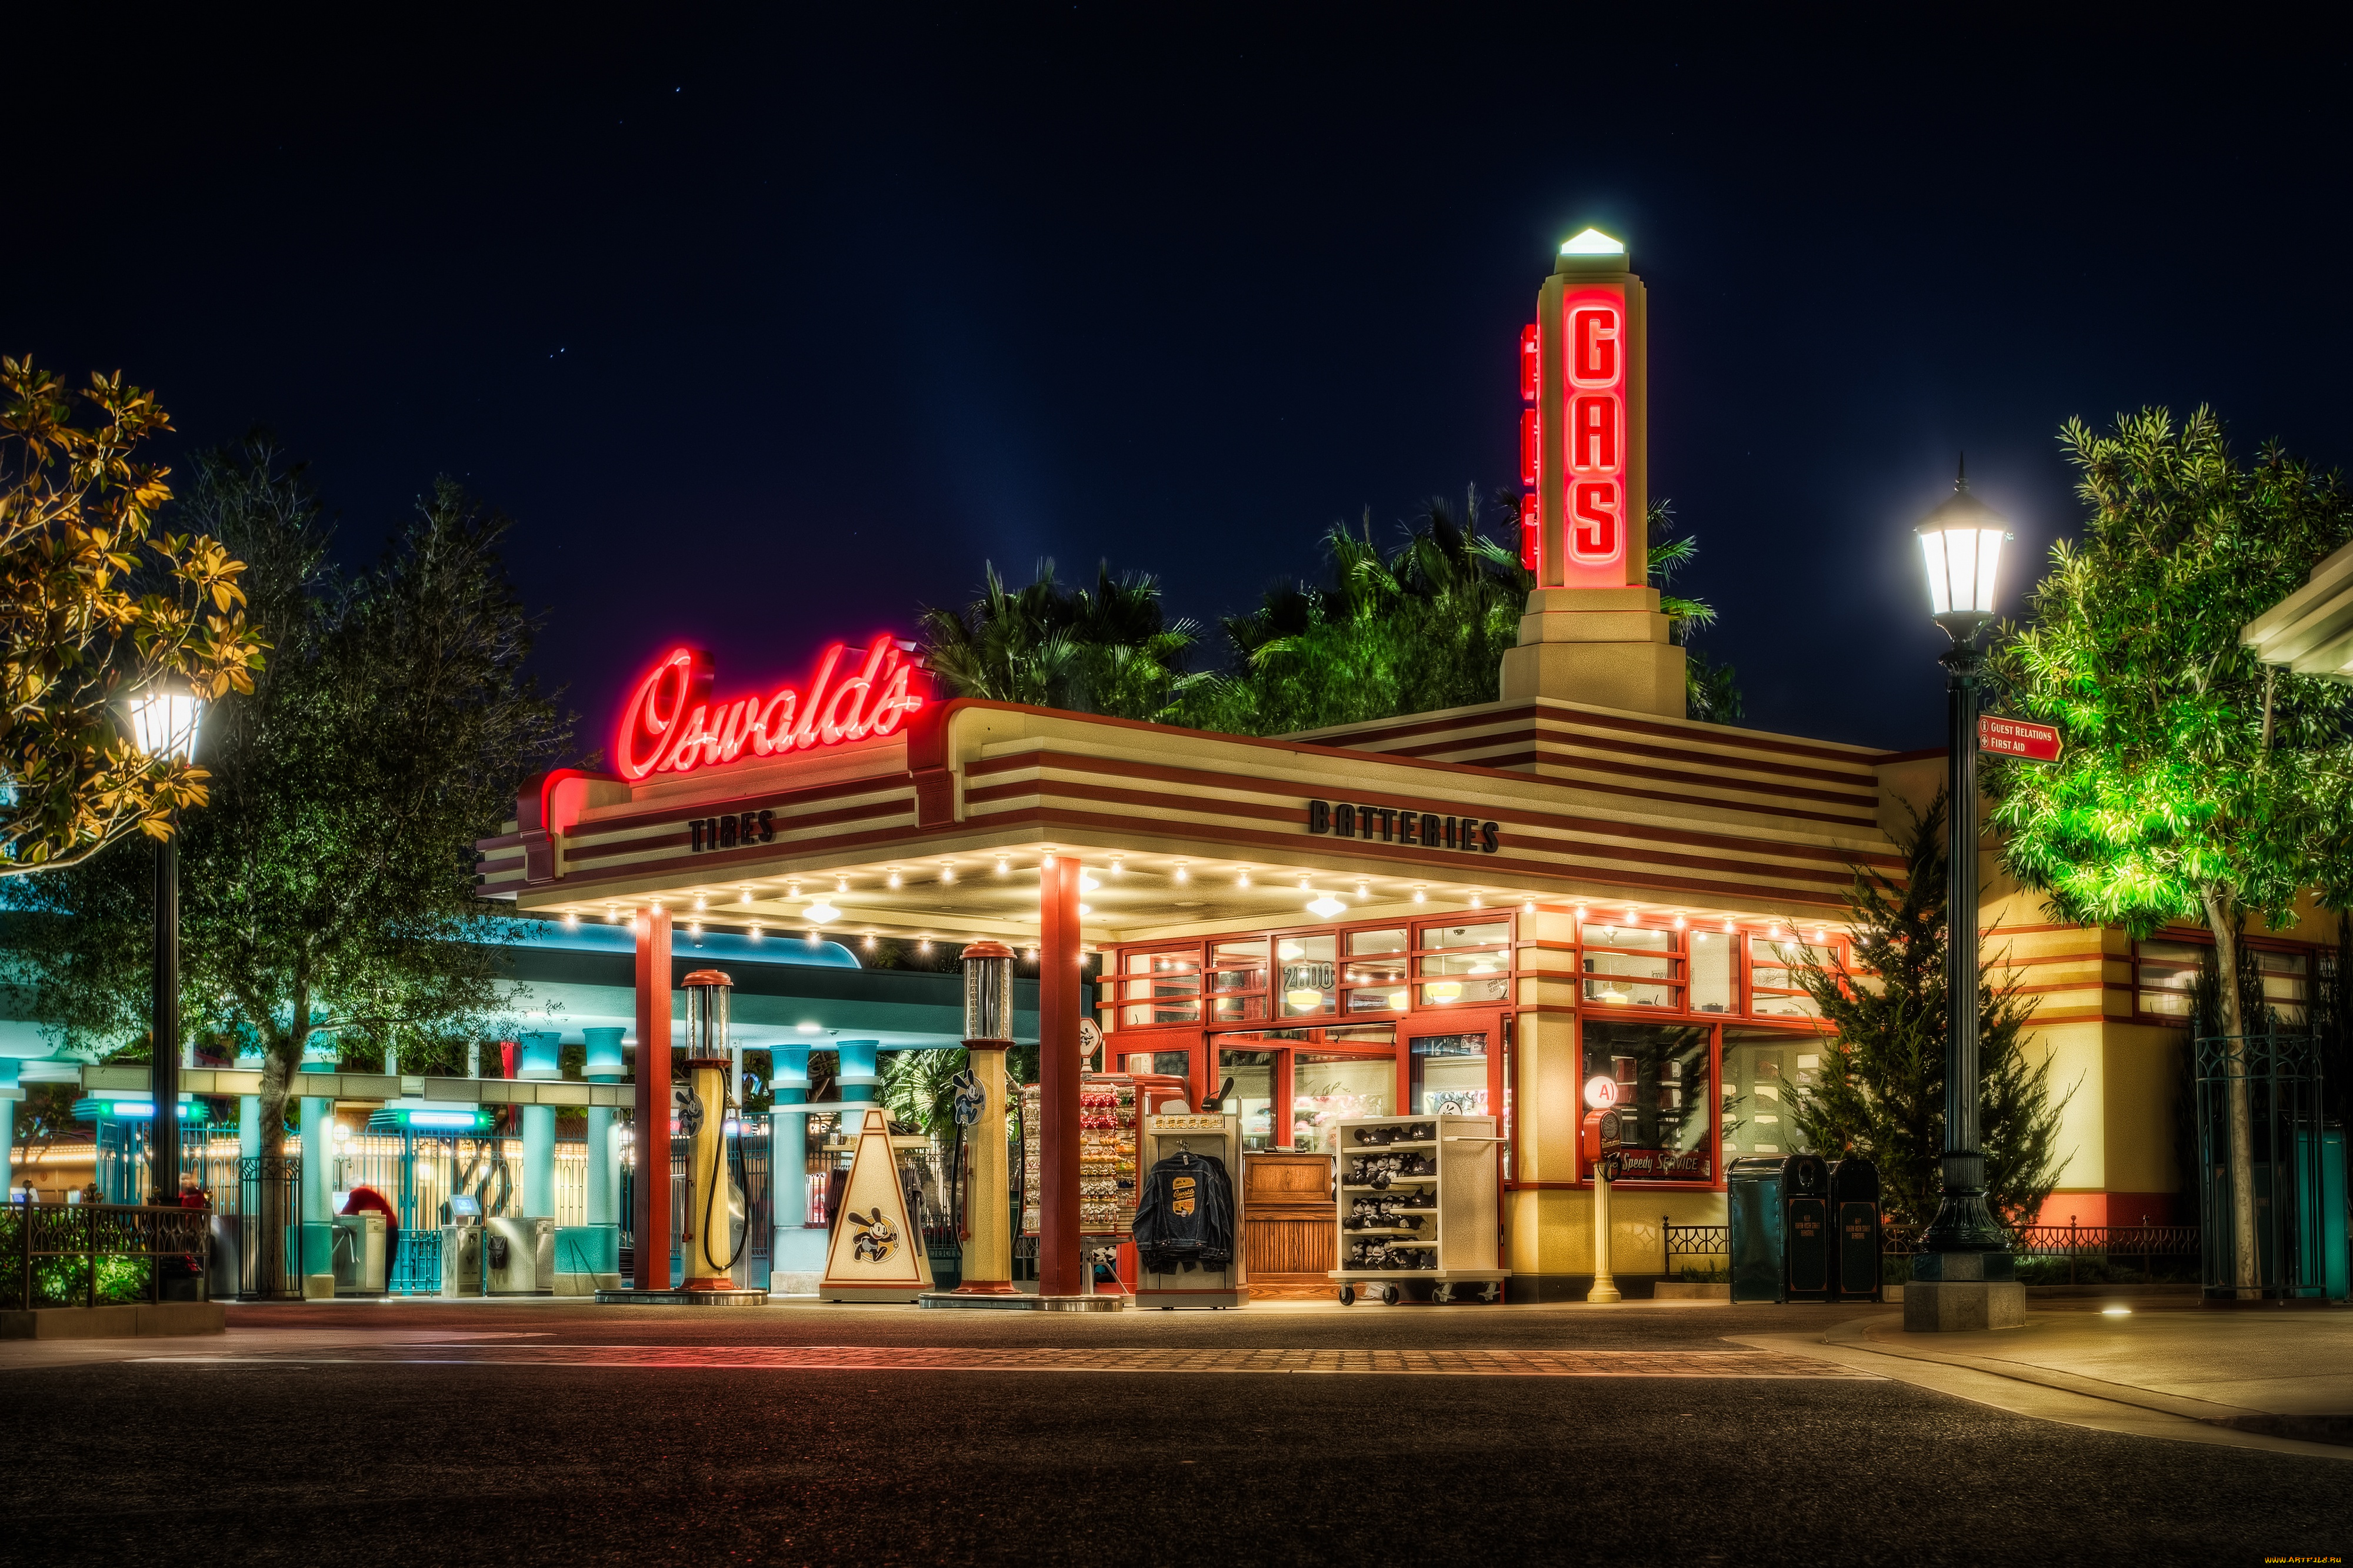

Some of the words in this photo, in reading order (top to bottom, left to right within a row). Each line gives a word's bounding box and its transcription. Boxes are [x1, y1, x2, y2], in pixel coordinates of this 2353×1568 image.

[1573, 308, 1617, 556] GAS
[618, 636, 922, 780] Oswald's
[1991, 722, 2013, 735] GUEST
[2015, 726, 2052, 742] RELATIONS
[1991, 737, 2011, 750] FIRST
[2013, 741, 2025, 752] AID
[688, 810, 774, 852] TIRES
[1311, 800, 1499, 853] BATTERIES
[1622, 1152, 1653, 1173] Speedy
[1656, 1153, 1699, 1170] SERVICE
